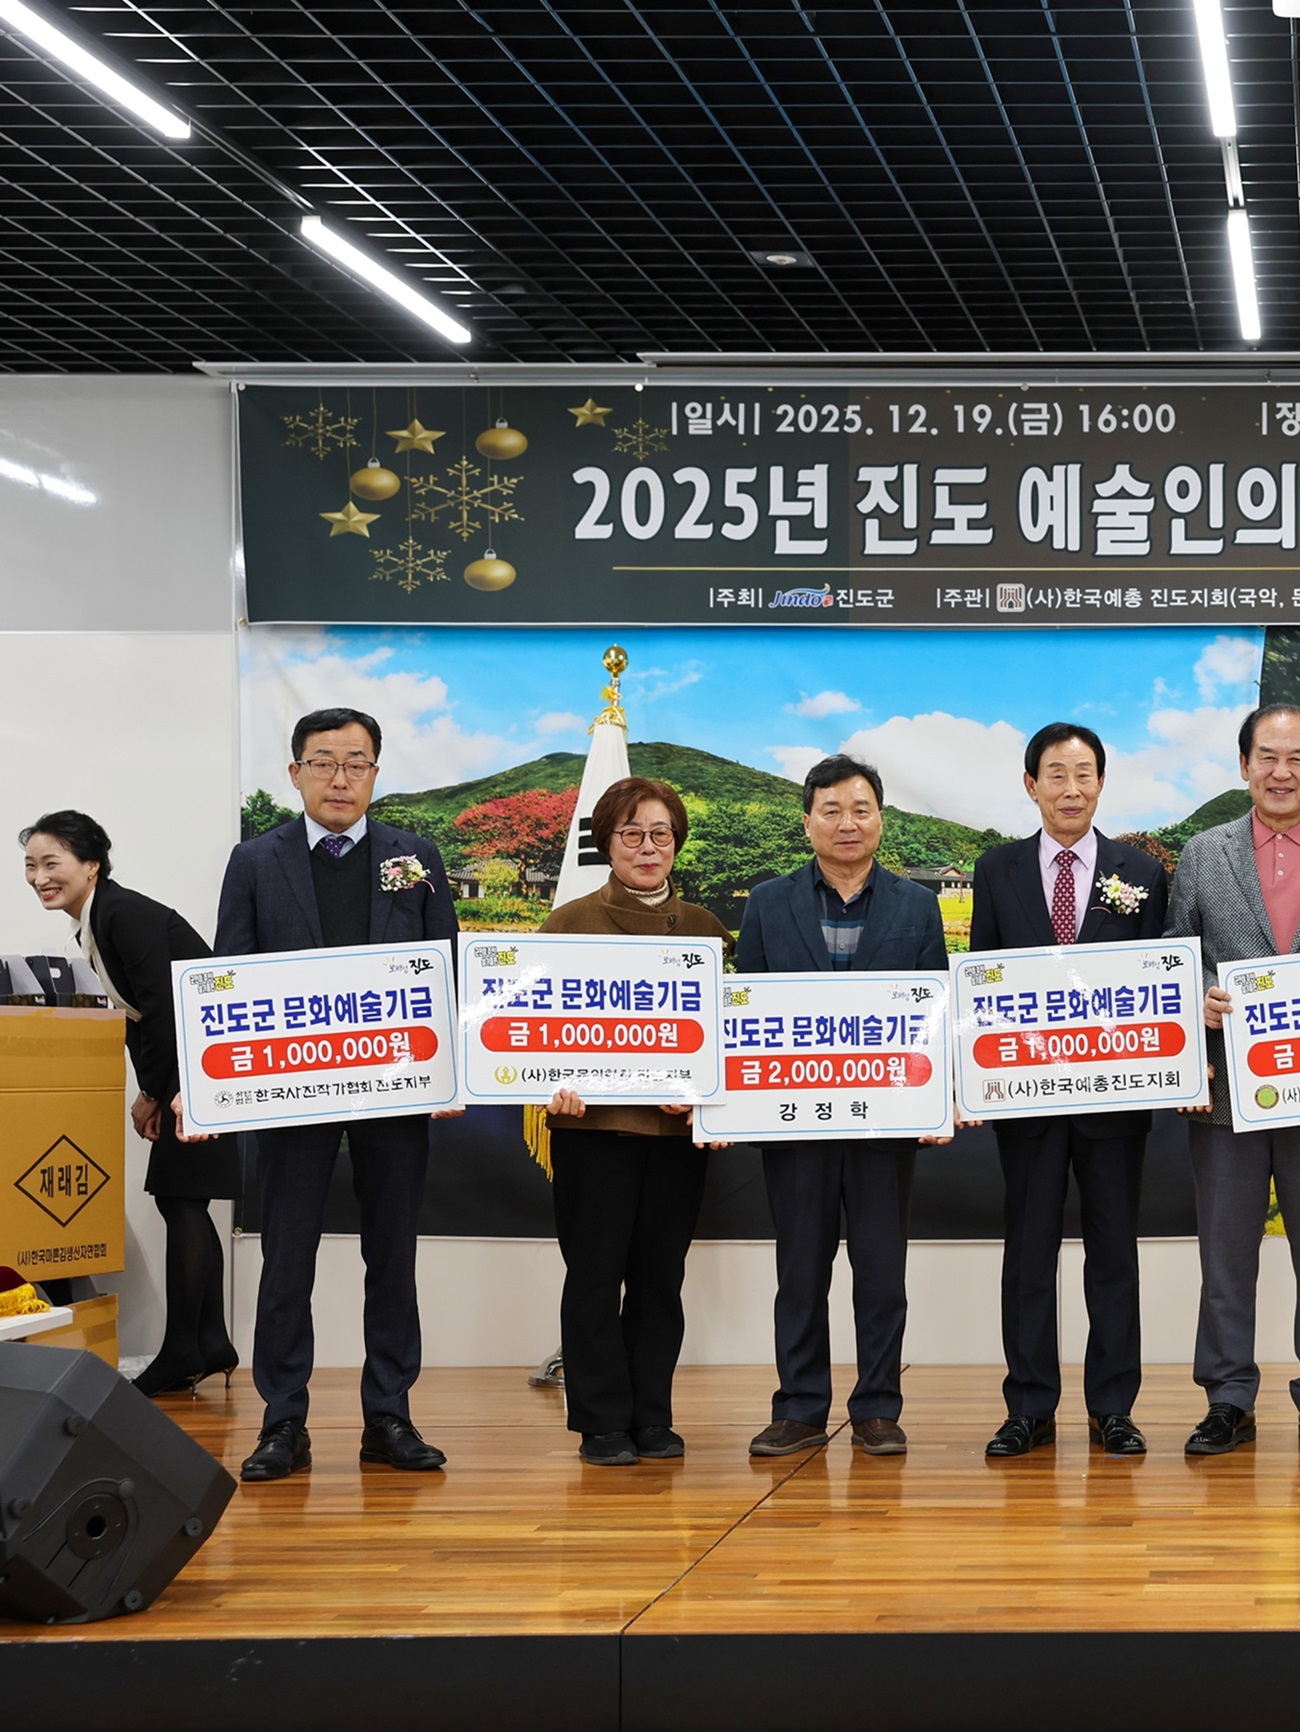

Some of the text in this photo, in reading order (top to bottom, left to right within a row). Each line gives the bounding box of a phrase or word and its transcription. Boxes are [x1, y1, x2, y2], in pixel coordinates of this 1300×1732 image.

[776, 404, 874, 435] 2025.
[890, 404, 939, 435] 12.
[1078, 404, 1176, 434] 16:00
[572, 462, 830, 556] 2025년
[854, 462, 994, 556] 진도
[1017, 461, 1297, 556] 예술인의
[836, 588, 895, 608] 진도군
[1026, 588, 1142, 610] (사)한국예총
[1151, 588, 1285, 610] 진도지회(국악,
[409, 957, 434, 975] 진도
[682, 952, 705, 969] 진도
[1161, 954, 1184, 971] 진도
[561, 978, 702, 1011] 문화예술기금
[911, 986, 934, 1003] 진도
[1046, 983, 1181, 1022] 문화예술기금
[201, 986, 433, 1036] 진도군 문화예술기금
[508, 1022, 678, 1048] 금 1,000,000원
[724, 1014, 929, 1048] 진도군 문화예술기금
[998, 1027, 1160, 1062] 금 1,000,000원
[231, 1031, 411, 1072] 금 1,000,000원
[1273, 1044, 1294, 1069] 금
[637, 1067, 692, 1083] 진지부
[741, 1057, 906, 1086] 금 2,000,000원
[1008, 1070, 1180, 1098] (사)한국예총진도지회
[254, 1081, 373, 1103] 한국사진작가협회
[376, 1075, 431, 1092] 진도지부
[780, 1100, 868, 1121] 강 정 학
[40, 1163, 88, 1198] 재래김
